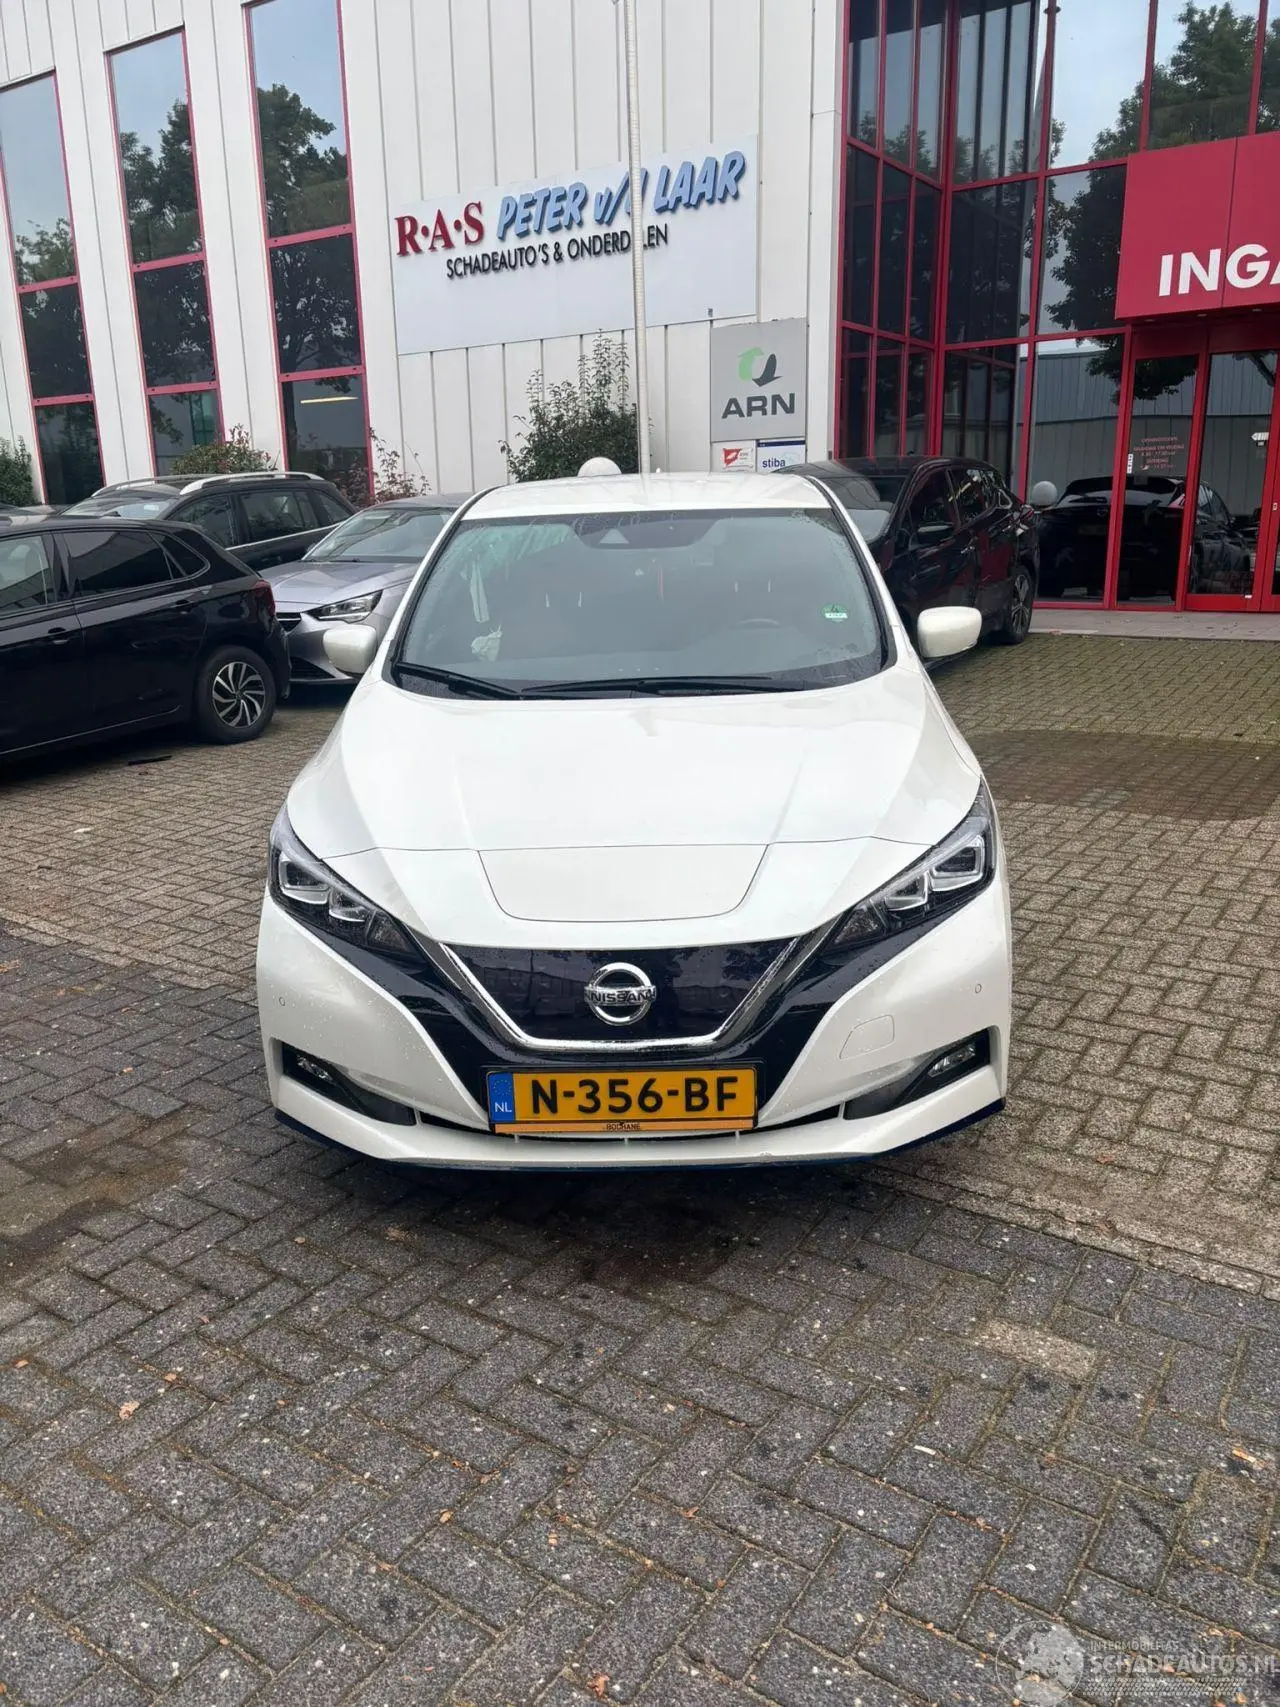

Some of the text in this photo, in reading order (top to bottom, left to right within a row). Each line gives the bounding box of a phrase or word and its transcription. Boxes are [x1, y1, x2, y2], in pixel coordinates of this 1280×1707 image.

[496, 181, 588, 241] PETER
[653, 150, 747, 214] LAAR
[446, 223, 669, 279] SCHADEAUTO'S & ONDERDEN
[721, 392, 796, 420] ARN
[762, 457, 786, 468] stiba
[589, 989, 652, 1004] NISSAN
[494, 1102, 513, 1114] NL
[530, 1076, 739, 1115] N-356-BF
